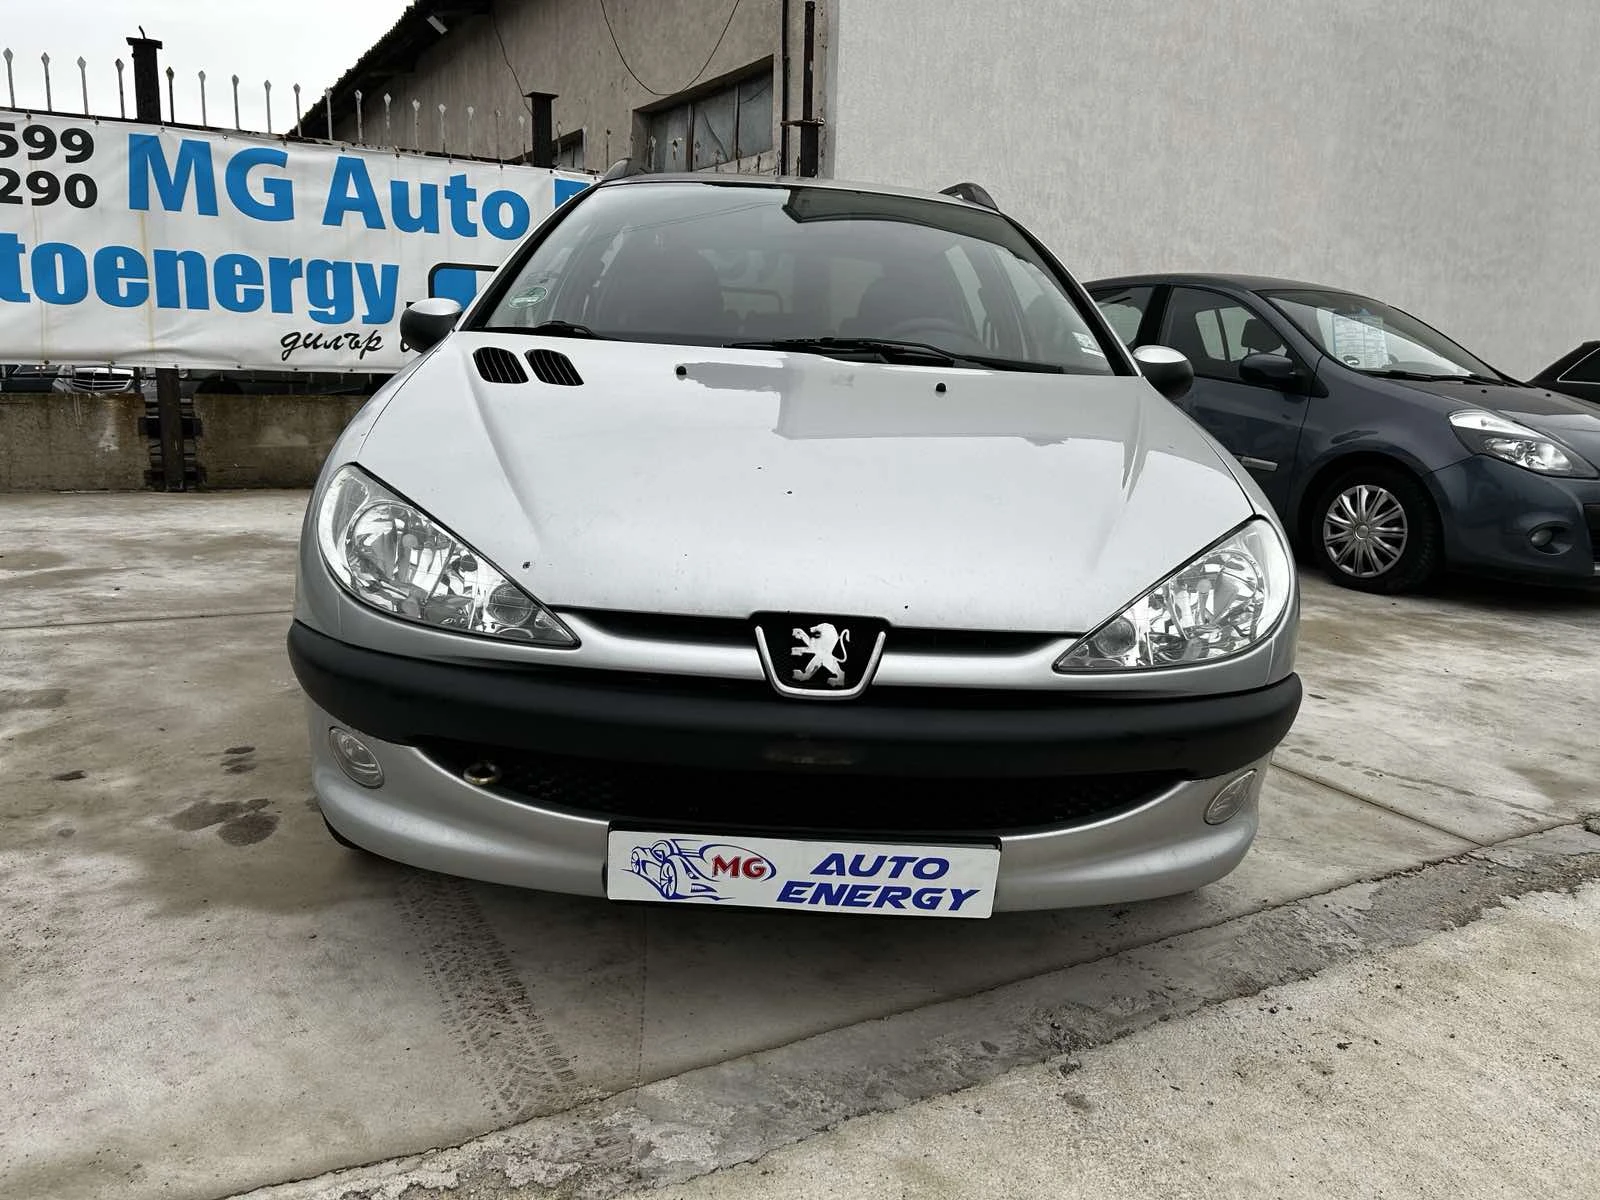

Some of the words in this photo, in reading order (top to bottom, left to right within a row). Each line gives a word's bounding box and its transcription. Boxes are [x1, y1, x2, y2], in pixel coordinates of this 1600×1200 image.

[0, 167, 98, 209] 290
[128, 133, 295, 222] MG
[322, 155, 530, 241] Auto
[0, 231, 400, 325] toenergy
[280, 329, 384, 362] дилър
[711, 854, 767, 880] MG
[810, 852, 950, 881] AUTO
[776, 880, 981, 912] ENERGY
